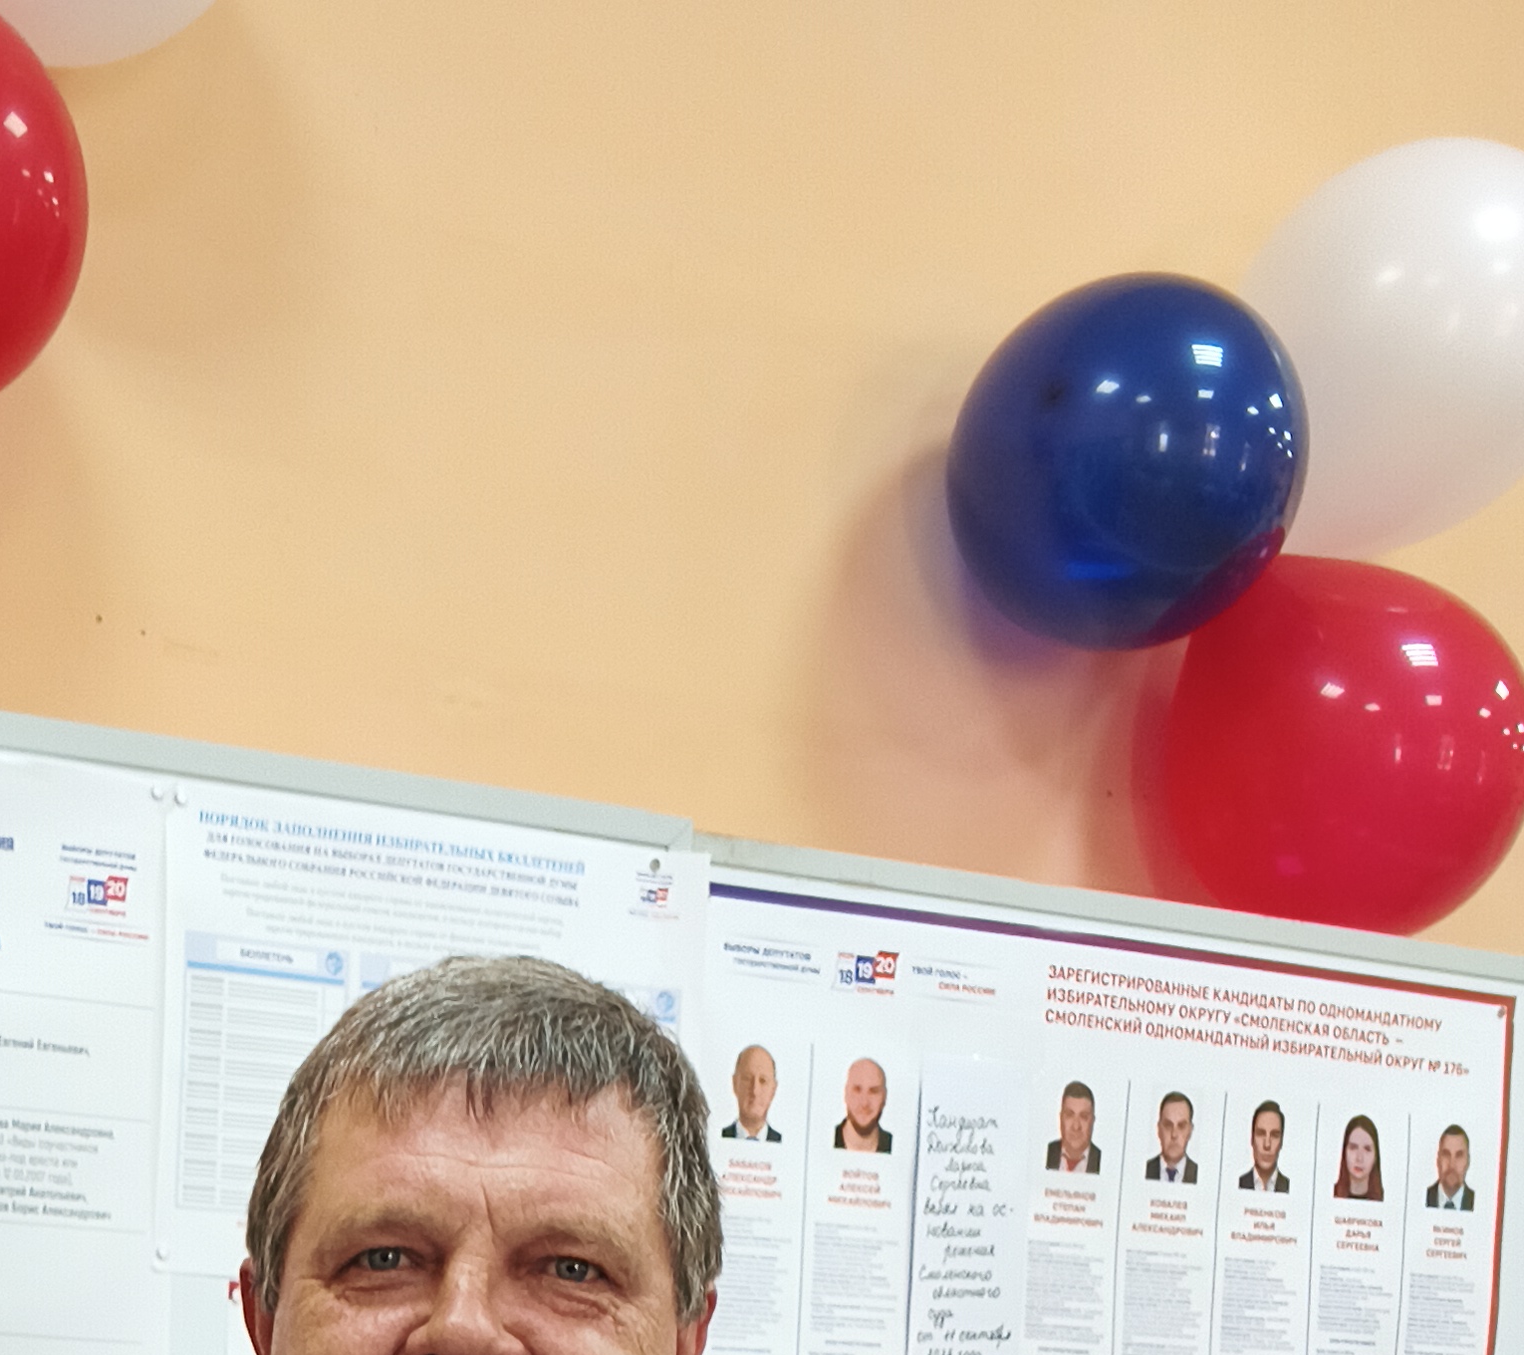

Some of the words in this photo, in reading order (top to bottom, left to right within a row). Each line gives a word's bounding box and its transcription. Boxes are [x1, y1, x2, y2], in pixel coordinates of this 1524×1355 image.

[106, 881, 124, 897] 20
[839, 969, 853, 986] 18
[858, 961, 873, 979] 19
[877, 957, 895, 974] 20
[1048, 964, 1208, 1000] ЗАРЕГИСТРИРОВАННЫЕ
[1212, 987, 1294, 1013] КАНДИДАТЫ
[1297, 998, 1315, 1015] ПО
[1318, 1002, 1441, 1033] ОДНОМАНДАТНОМУ
[1045, 1007, 1142, 1034] СМОЛЕНСКИЙ
[1145, 1021, 1269, 1052] ОДНОМАНДАТНЫЙ
[1272, 1037, 1382, 1066] ИЗБИРАТЕЛЬНЫЙ
[1385, 1053, 1423, 1071] ОКРУГ
[1046, 986, 1175, 1017] ИЗБИРАТЕЛЬНОМУ
[1178, 1004, 1230, 1025] ОКРУГУ
[1233, 1011, 1329, 1037] «СМОЛЕНСКАЯ
[1332, 1024, 1389, 1046] ОБЛАСТЬ
